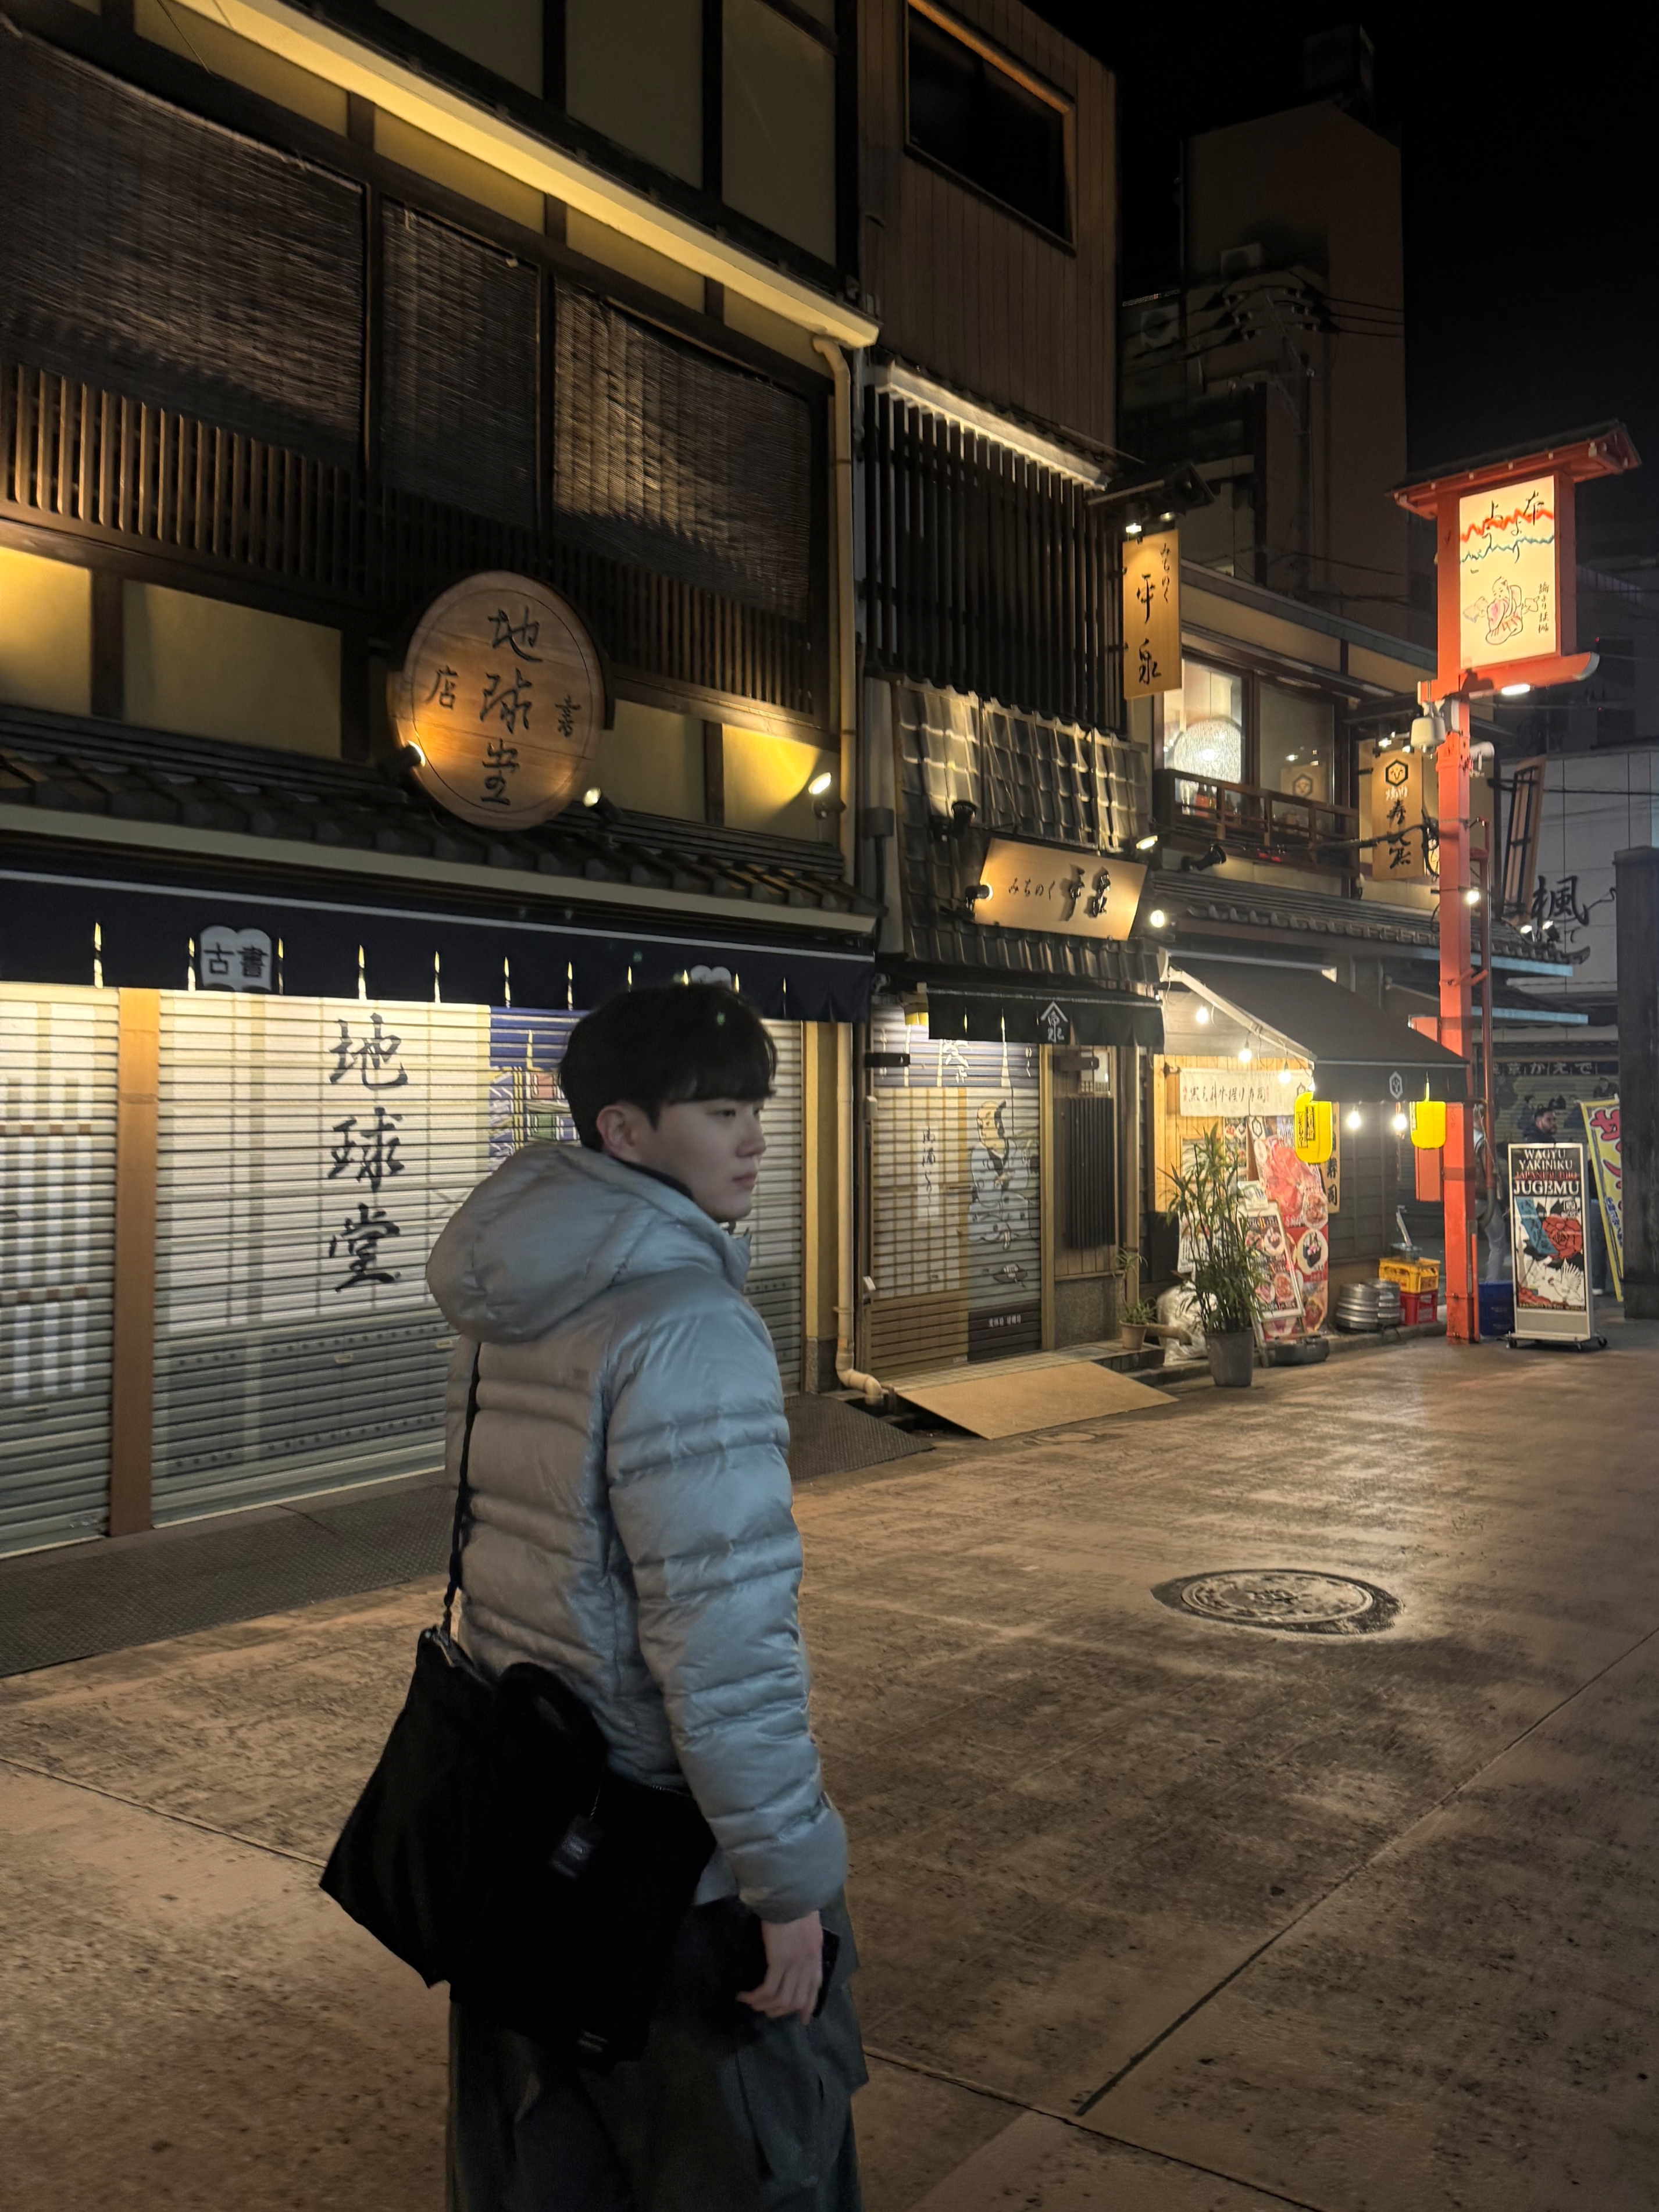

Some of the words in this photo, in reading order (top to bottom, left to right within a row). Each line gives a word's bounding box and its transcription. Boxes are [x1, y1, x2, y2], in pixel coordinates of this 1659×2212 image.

[1136, 573, 1162, 685] 平泉
[479, 605, 543, 806] 地球堂
[1530, 875, 1590, 928] 楓
[202, 942, 269, 978] 古書
[328, 1012, 409, 1293] 地球堂
[1518, 1159, 1573, 1170] YAKINIKU
[1524, 1149, 1565, 1160] WAGYU
[1513, 1180, 1580, 1195] JUGEMU
